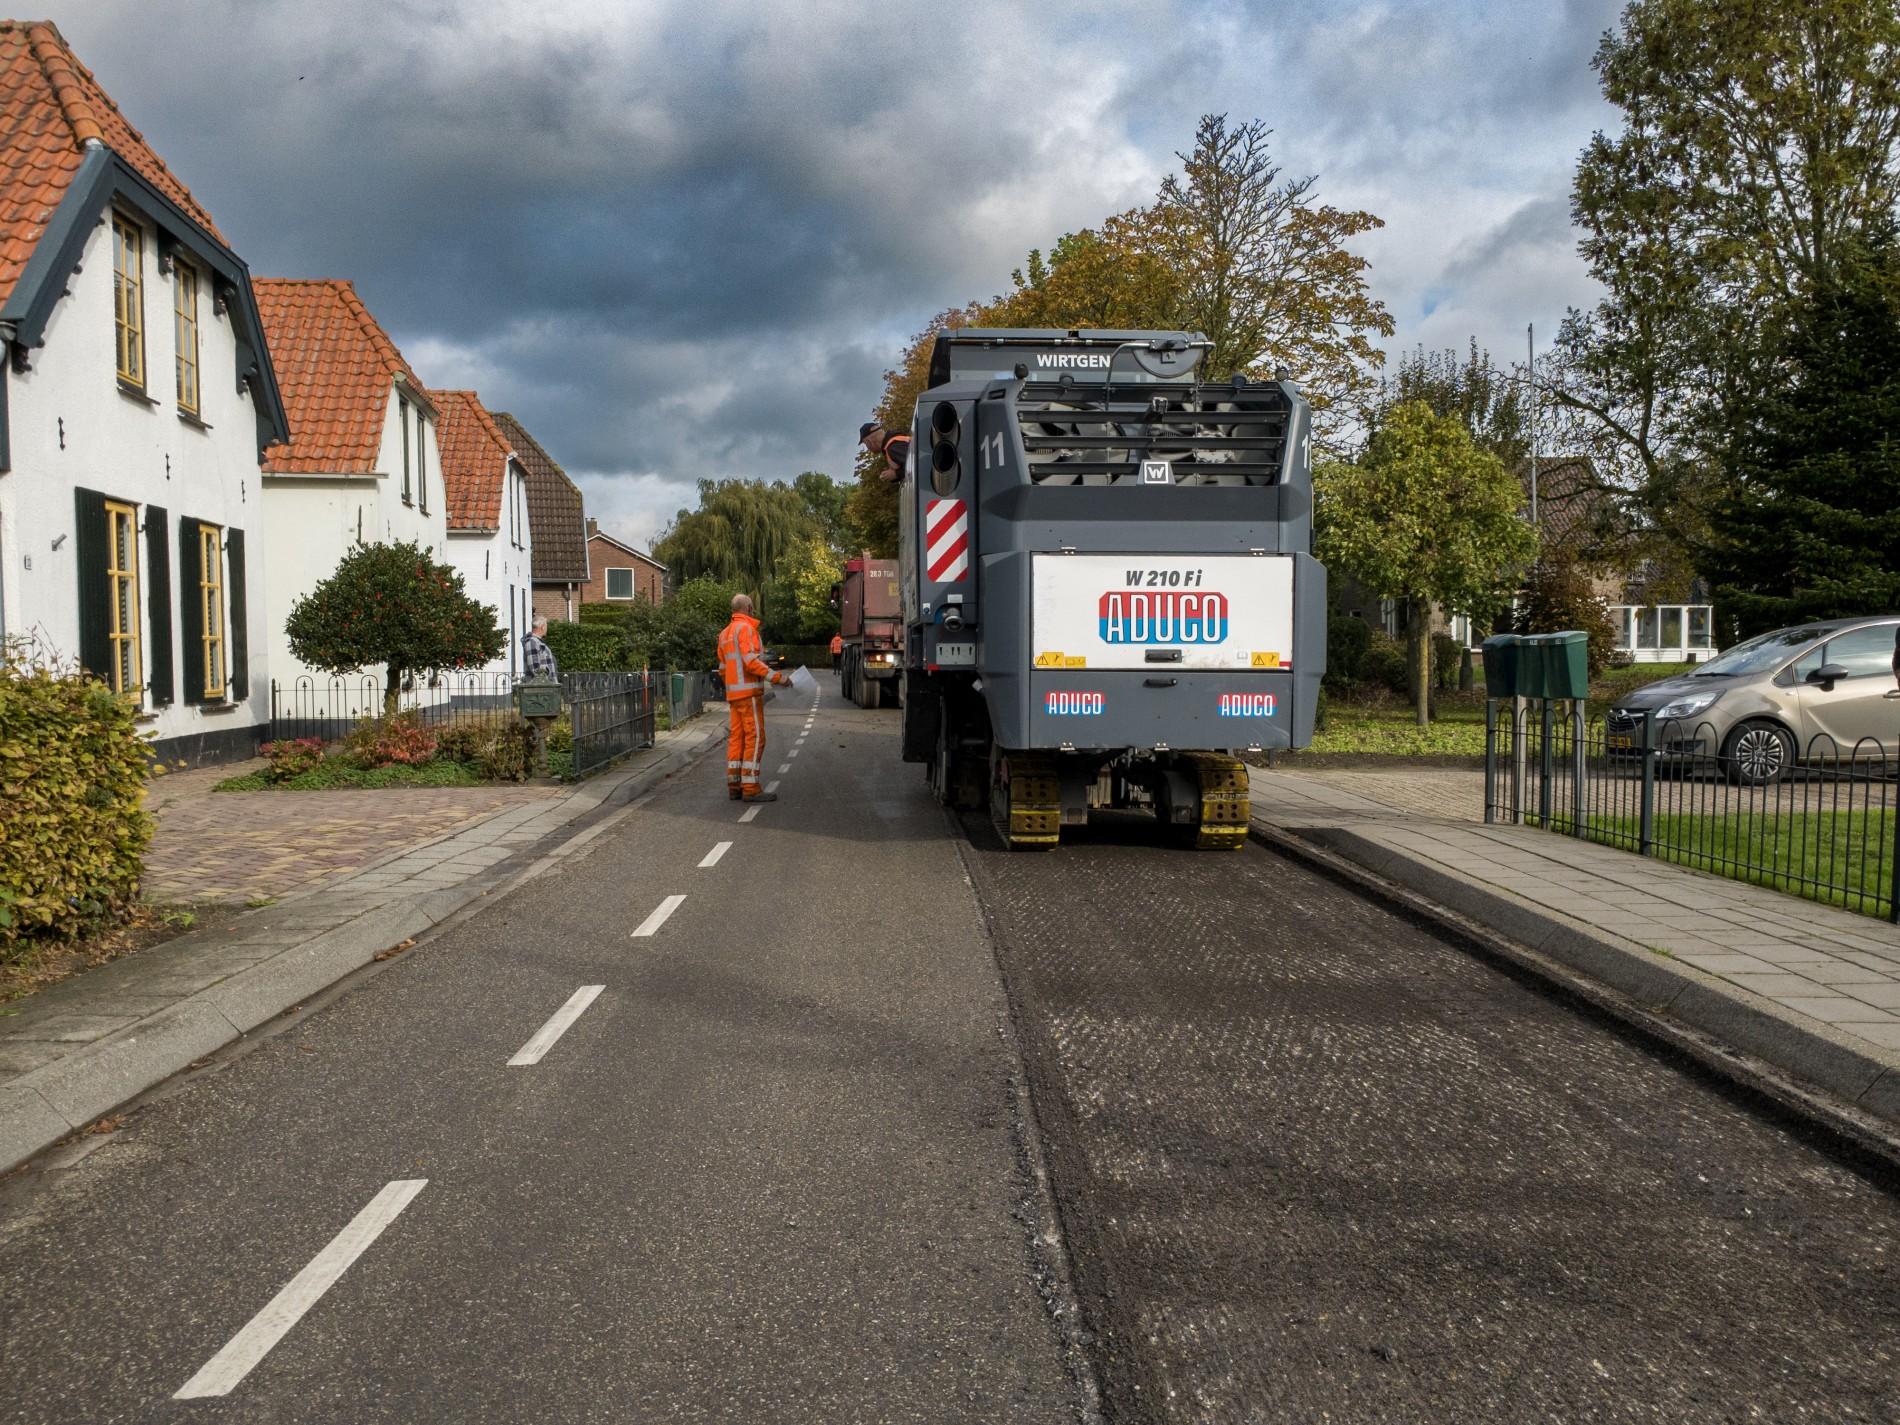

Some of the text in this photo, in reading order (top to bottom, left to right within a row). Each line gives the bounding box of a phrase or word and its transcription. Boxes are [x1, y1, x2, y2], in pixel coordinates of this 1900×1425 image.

[1036, 354, 1111, 368] WIRTGEN
[980, 431, 1005, 469] 11
[1126, 569, 1203, 587] W 210 Fi
[1106, 594, 1221, 643] ADUCO
[1048, 692, 1102, 715] ADUCO
[1221, 694, 1274, 716] ADUCO
